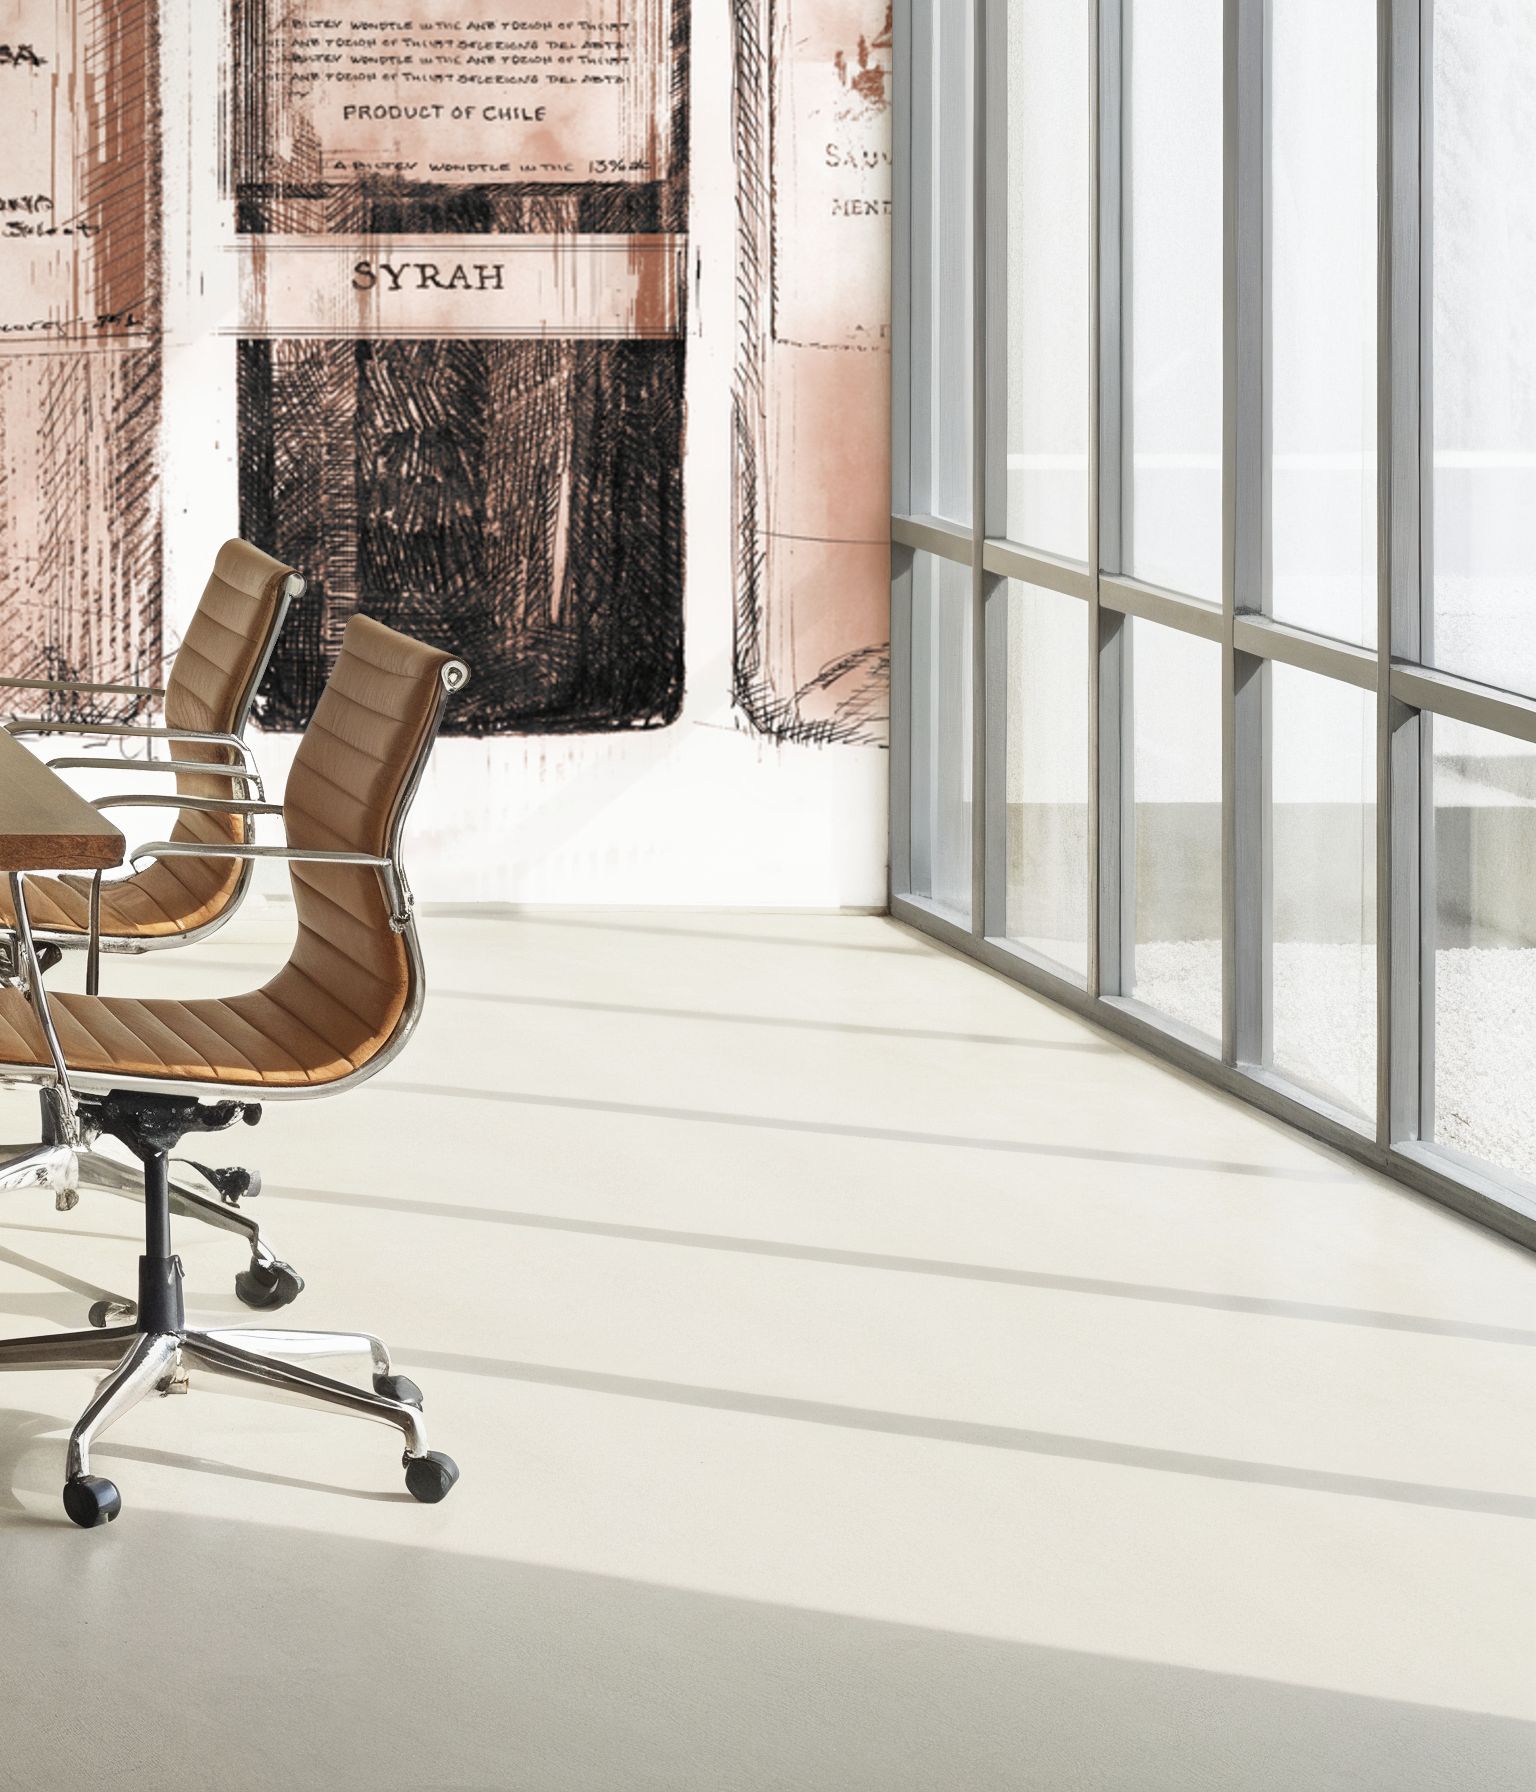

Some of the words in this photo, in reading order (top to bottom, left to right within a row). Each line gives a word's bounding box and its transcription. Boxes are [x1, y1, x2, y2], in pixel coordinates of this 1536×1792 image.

[342, 105, 444, 122] PRODUCT
[451, 105, 475, 120] OF
[483, 105, 547, 122] CHILE
[352, 261, 504, 291] SYRAH
